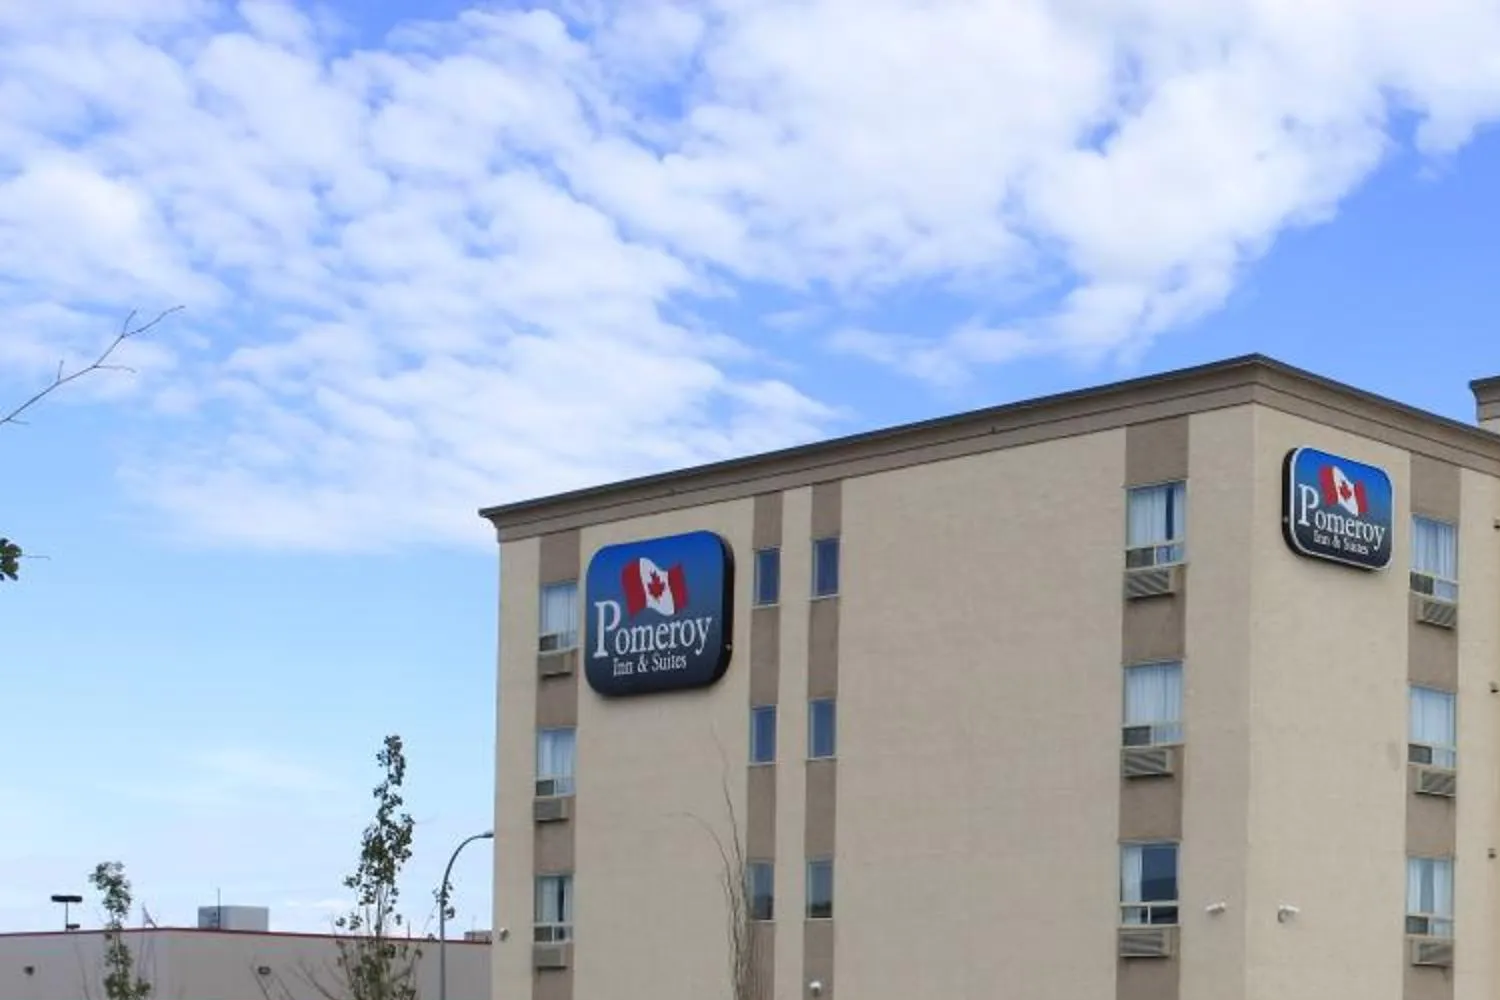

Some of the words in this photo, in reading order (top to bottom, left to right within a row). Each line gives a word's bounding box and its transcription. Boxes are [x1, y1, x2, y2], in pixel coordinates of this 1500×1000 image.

[1298, 483, 1385, 551] Pomeroy
[593, 600, 713, 658] Pomeroy
[613, 657, 634, 676] Inn
[637, 653, 648, 673] &
[651, 651, 687, 672] Suites
